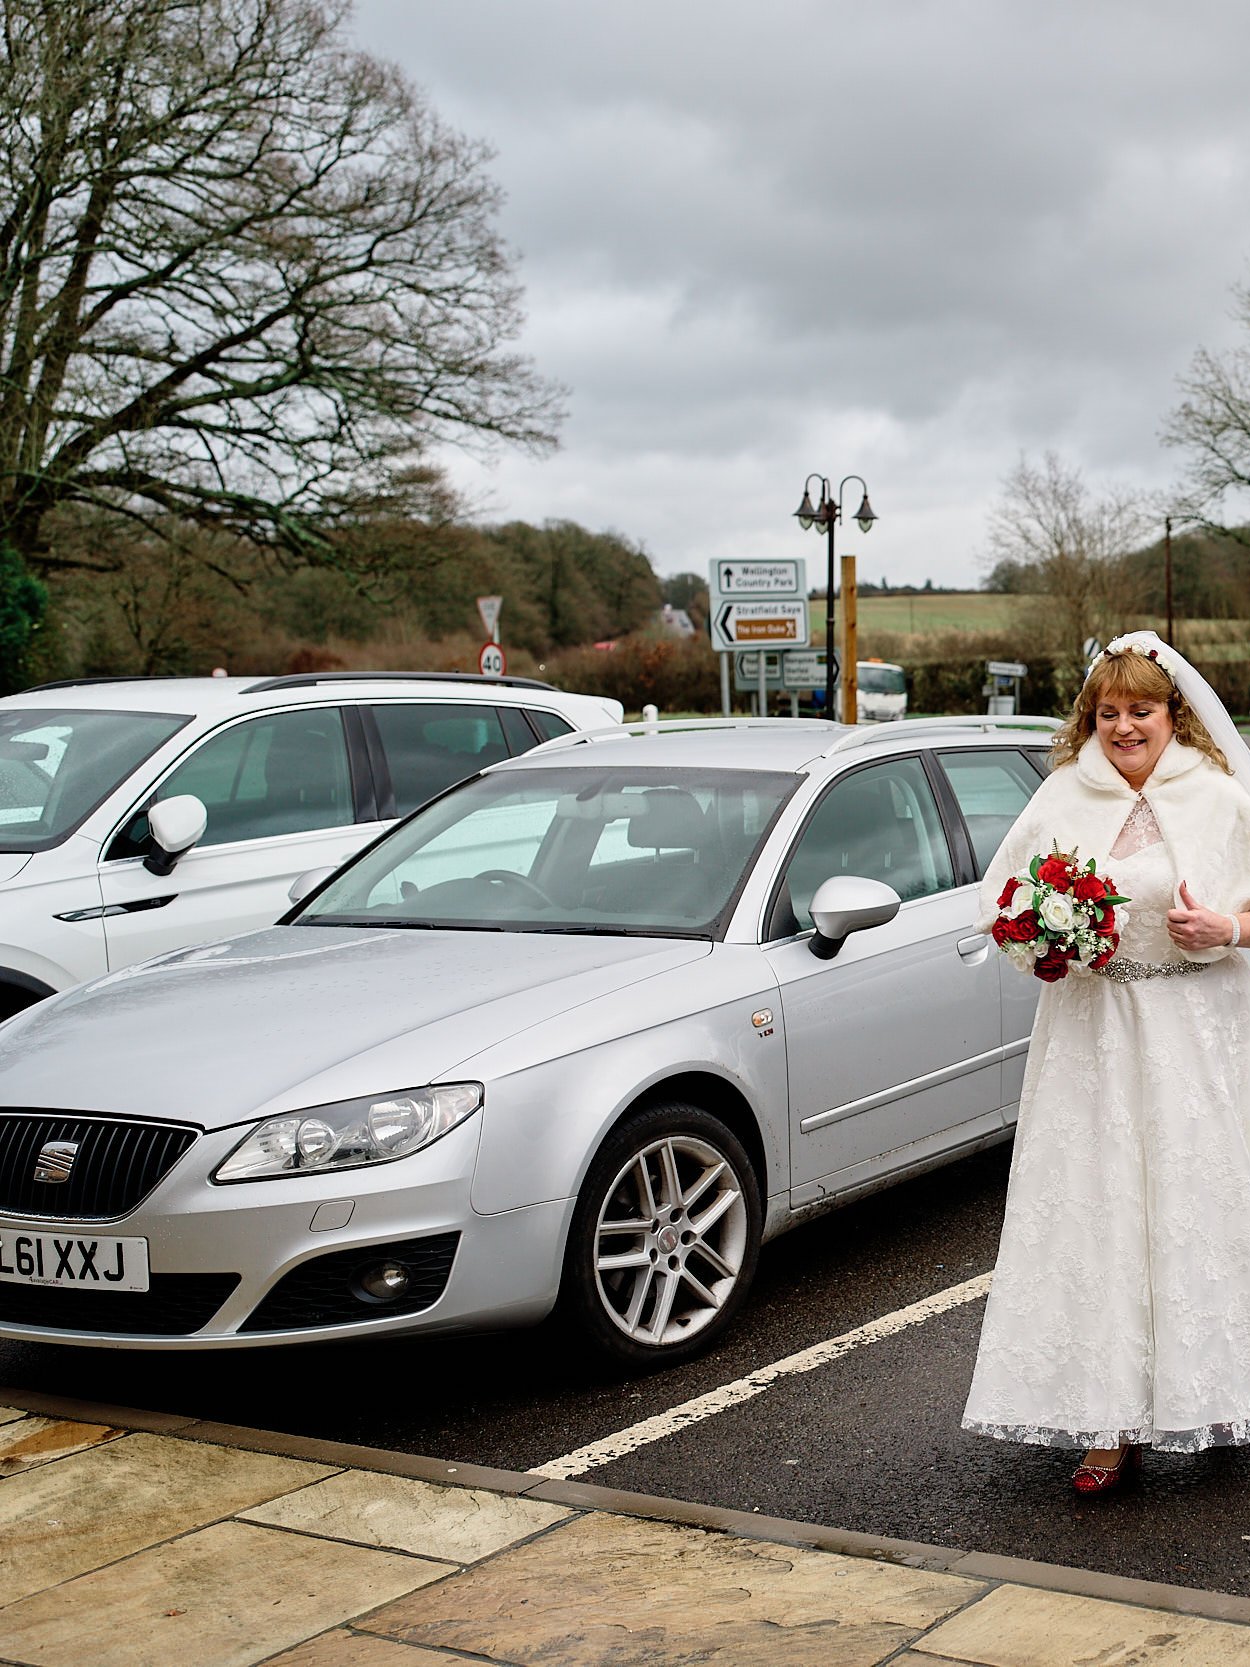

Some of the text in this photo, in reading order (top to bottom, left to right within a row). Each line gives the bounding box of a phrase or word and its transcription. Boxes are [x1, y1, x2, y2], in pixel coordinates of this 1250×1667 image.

[742, 567, 787, 577] Wellington
[735, 577, 793, 588] Country Park
[736, 605, 778, 615] Stratfield
[483, 655, 501, 673] 40
[0, 1234, 125, 1282] L61 XXJ
